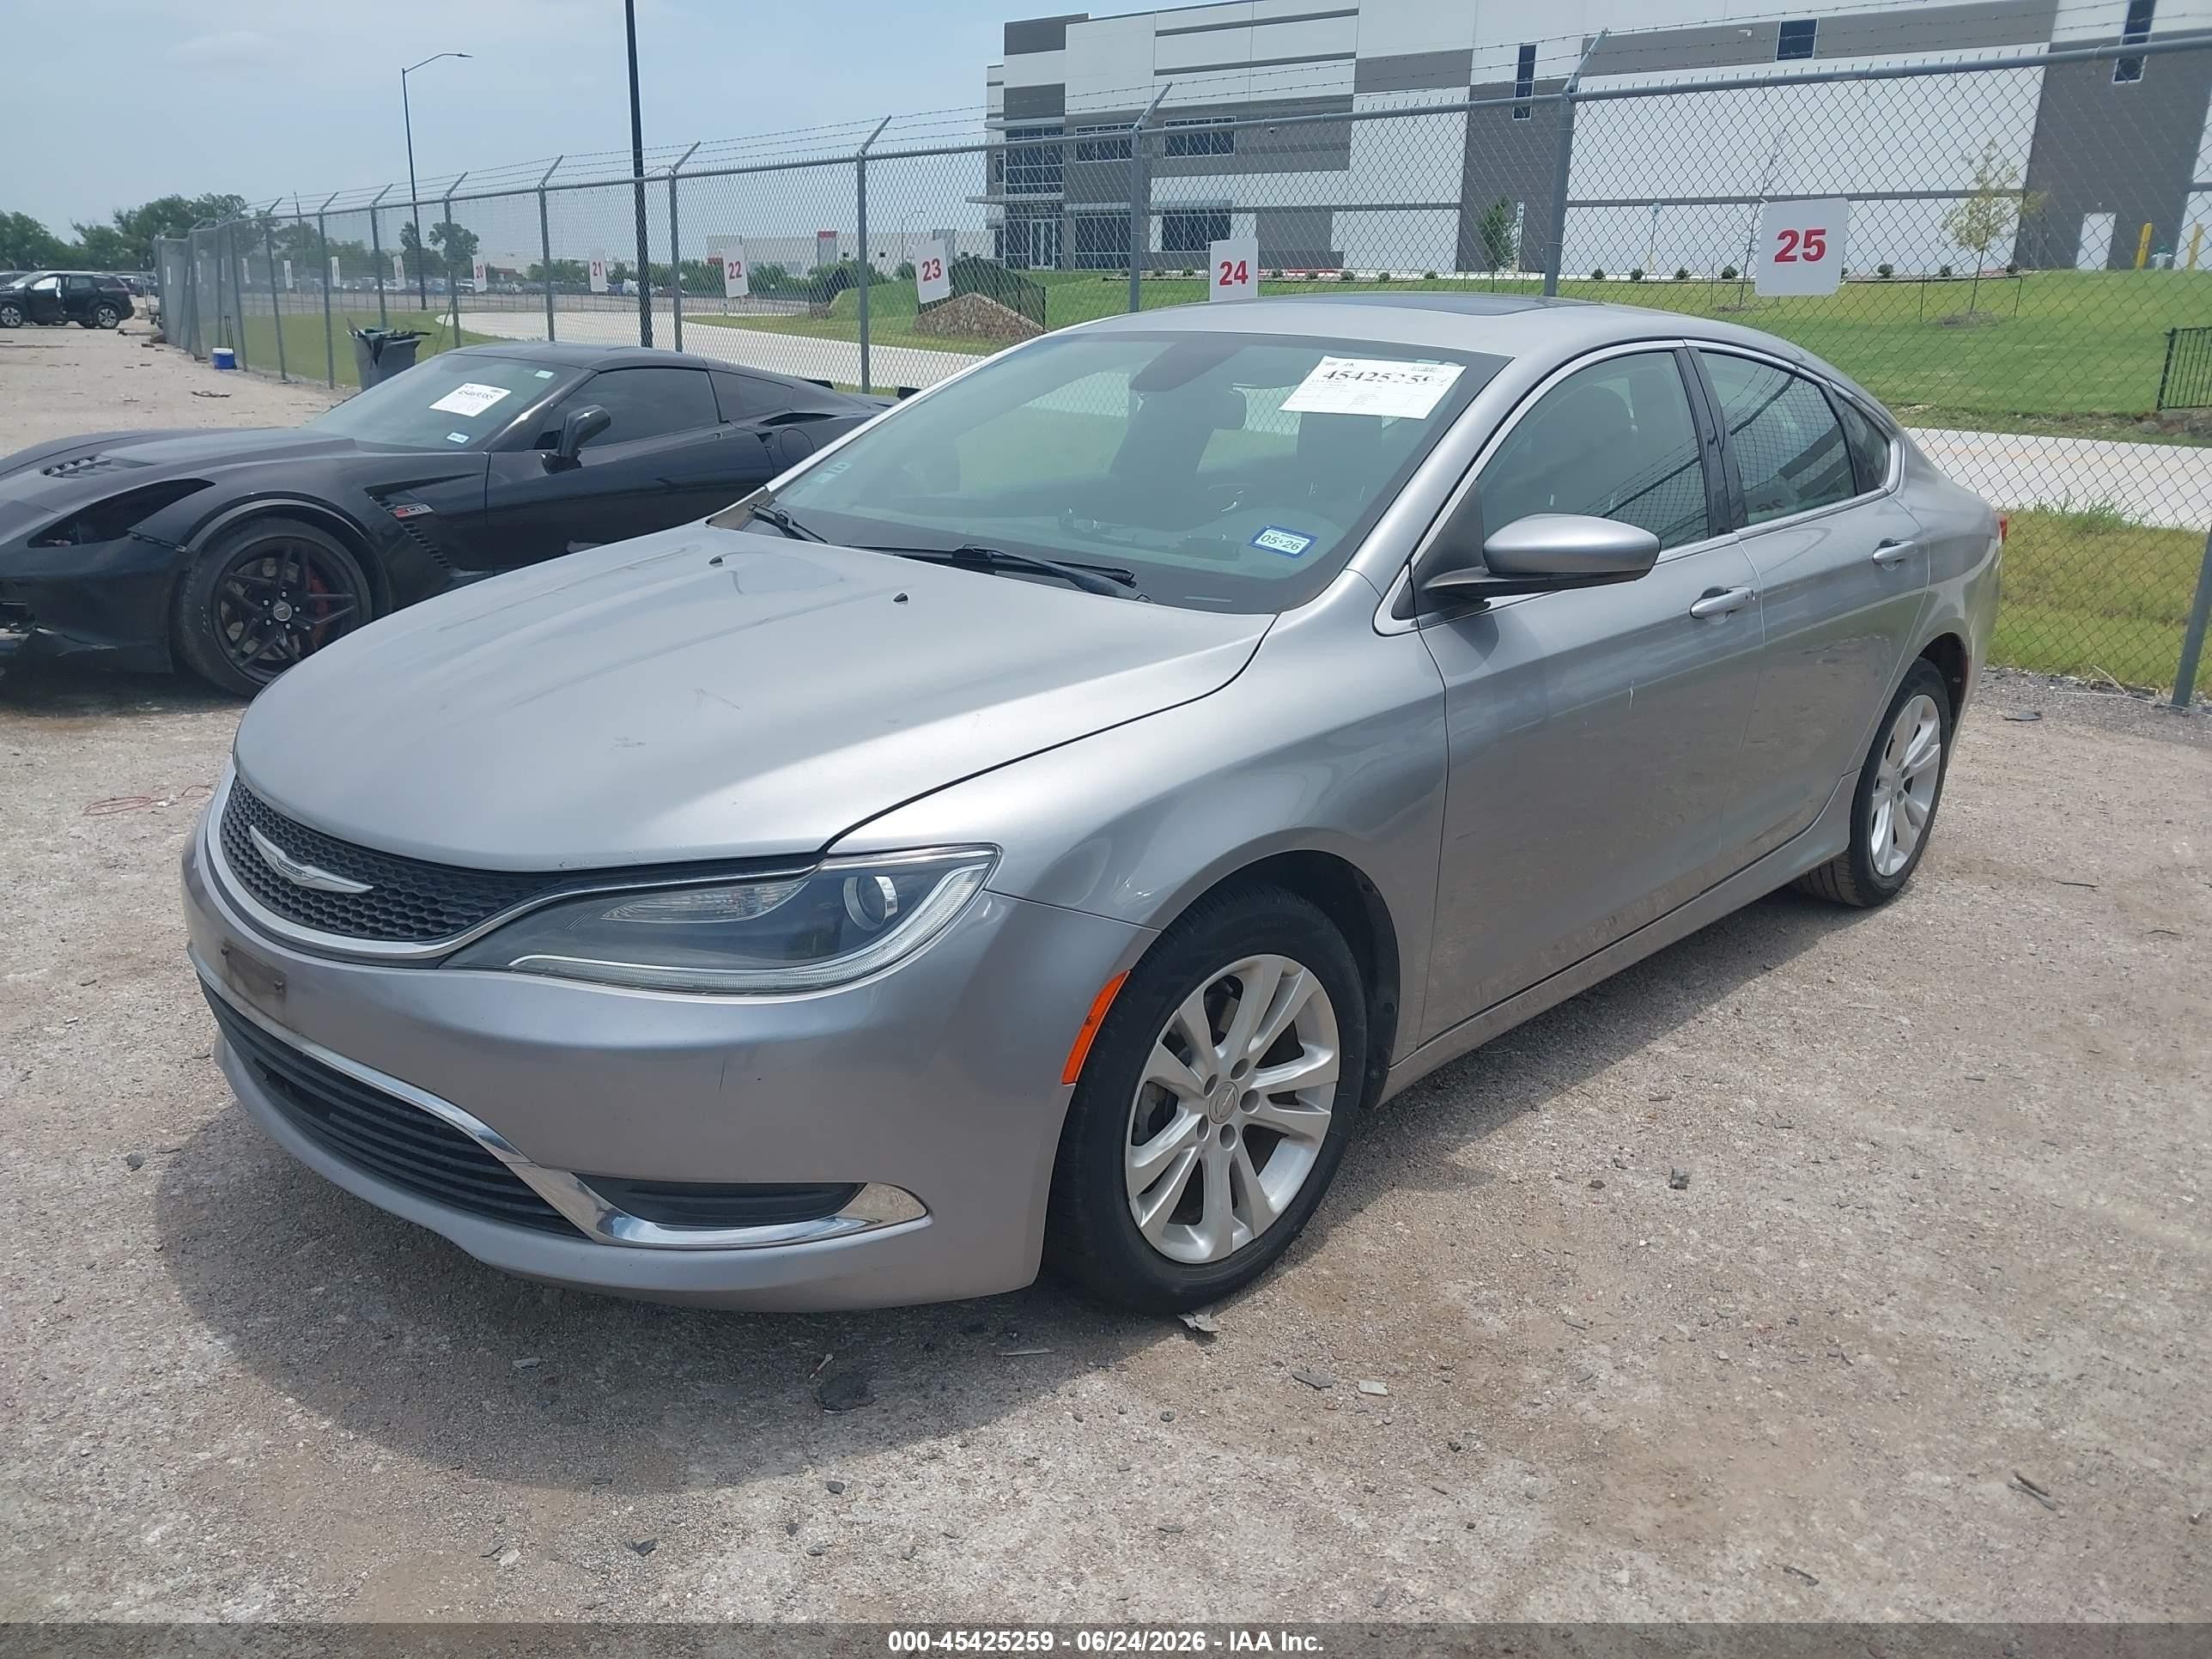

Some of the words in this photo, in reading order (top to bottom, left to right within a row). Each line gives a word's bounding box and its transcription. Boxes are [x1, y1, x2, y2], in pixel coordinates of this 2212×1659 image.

[1774, 228, 1826, 262] 25
[592, 261, 602, 276] 21
[728, 261, 743, 280] 22
[921, 258, 941, 282] 23
[1219, 260, 1249, 286] 24
